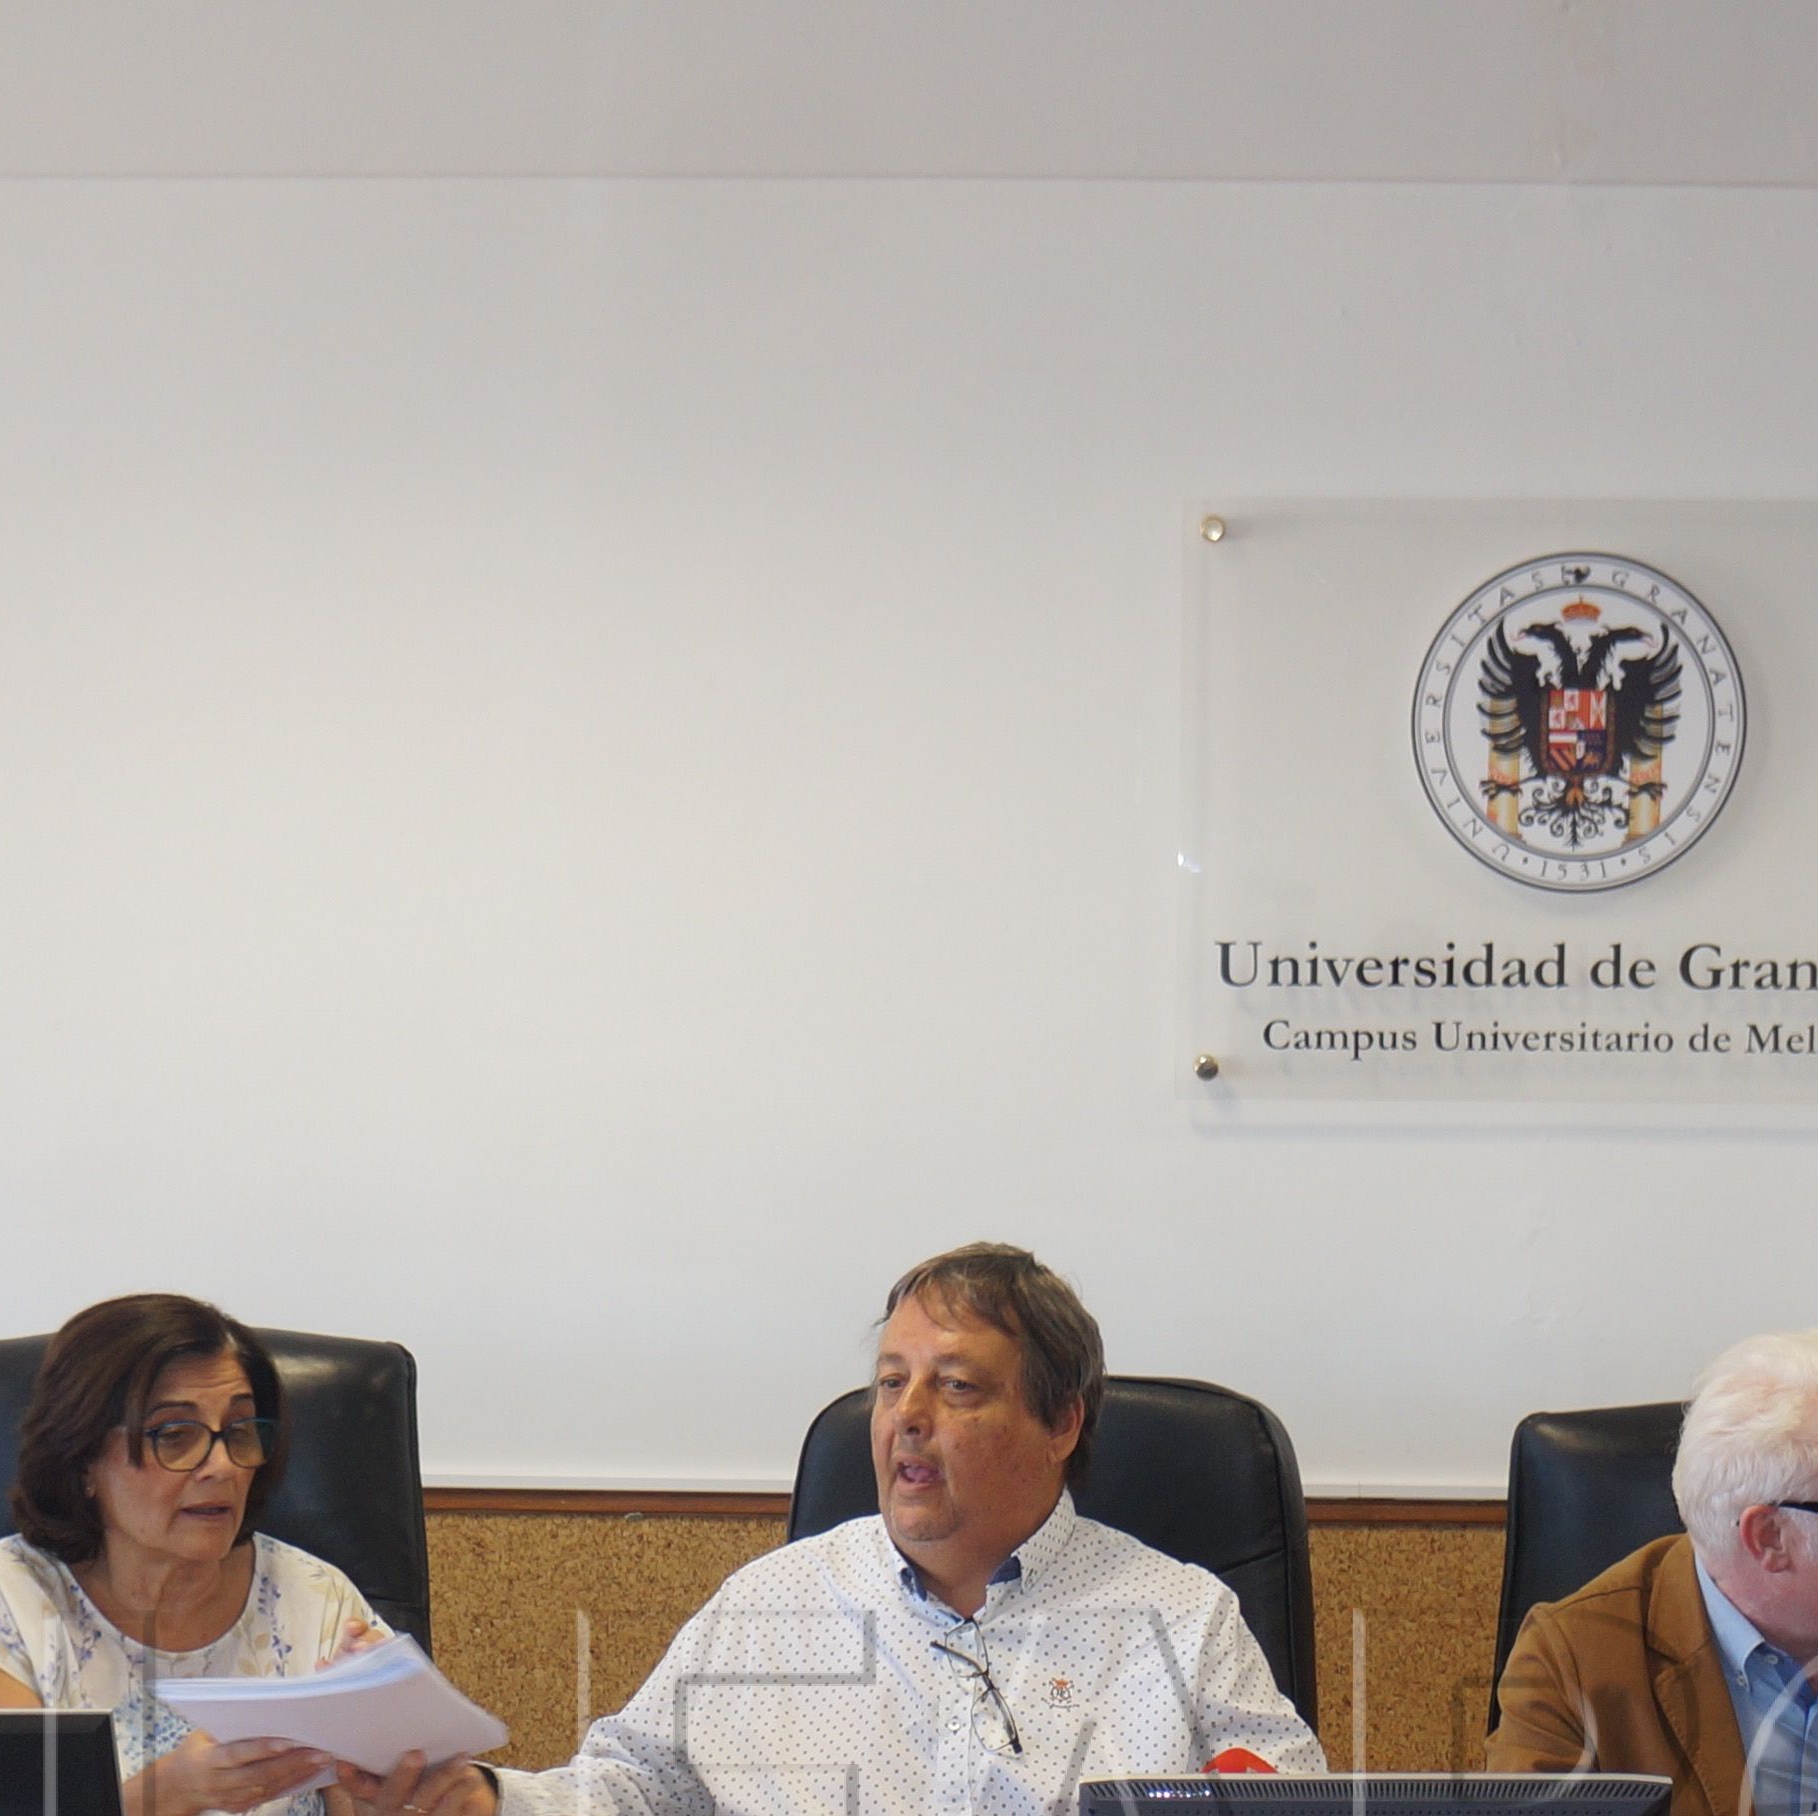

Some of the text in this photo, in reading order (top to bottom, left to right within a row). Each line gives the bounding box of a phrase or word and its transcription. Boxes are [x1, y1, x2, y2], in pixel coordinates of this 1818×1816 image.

[1541, 859, 1608, 881] 1531
[1214, 940, 1570, 989] Universidad
[1589, 942, 1657, 990] de
[1262, 1019, 1417, 1061] Campus
[1432, 1021, 1674, 1053] Universitario
[1688, 1022, 1732, 1053] de
